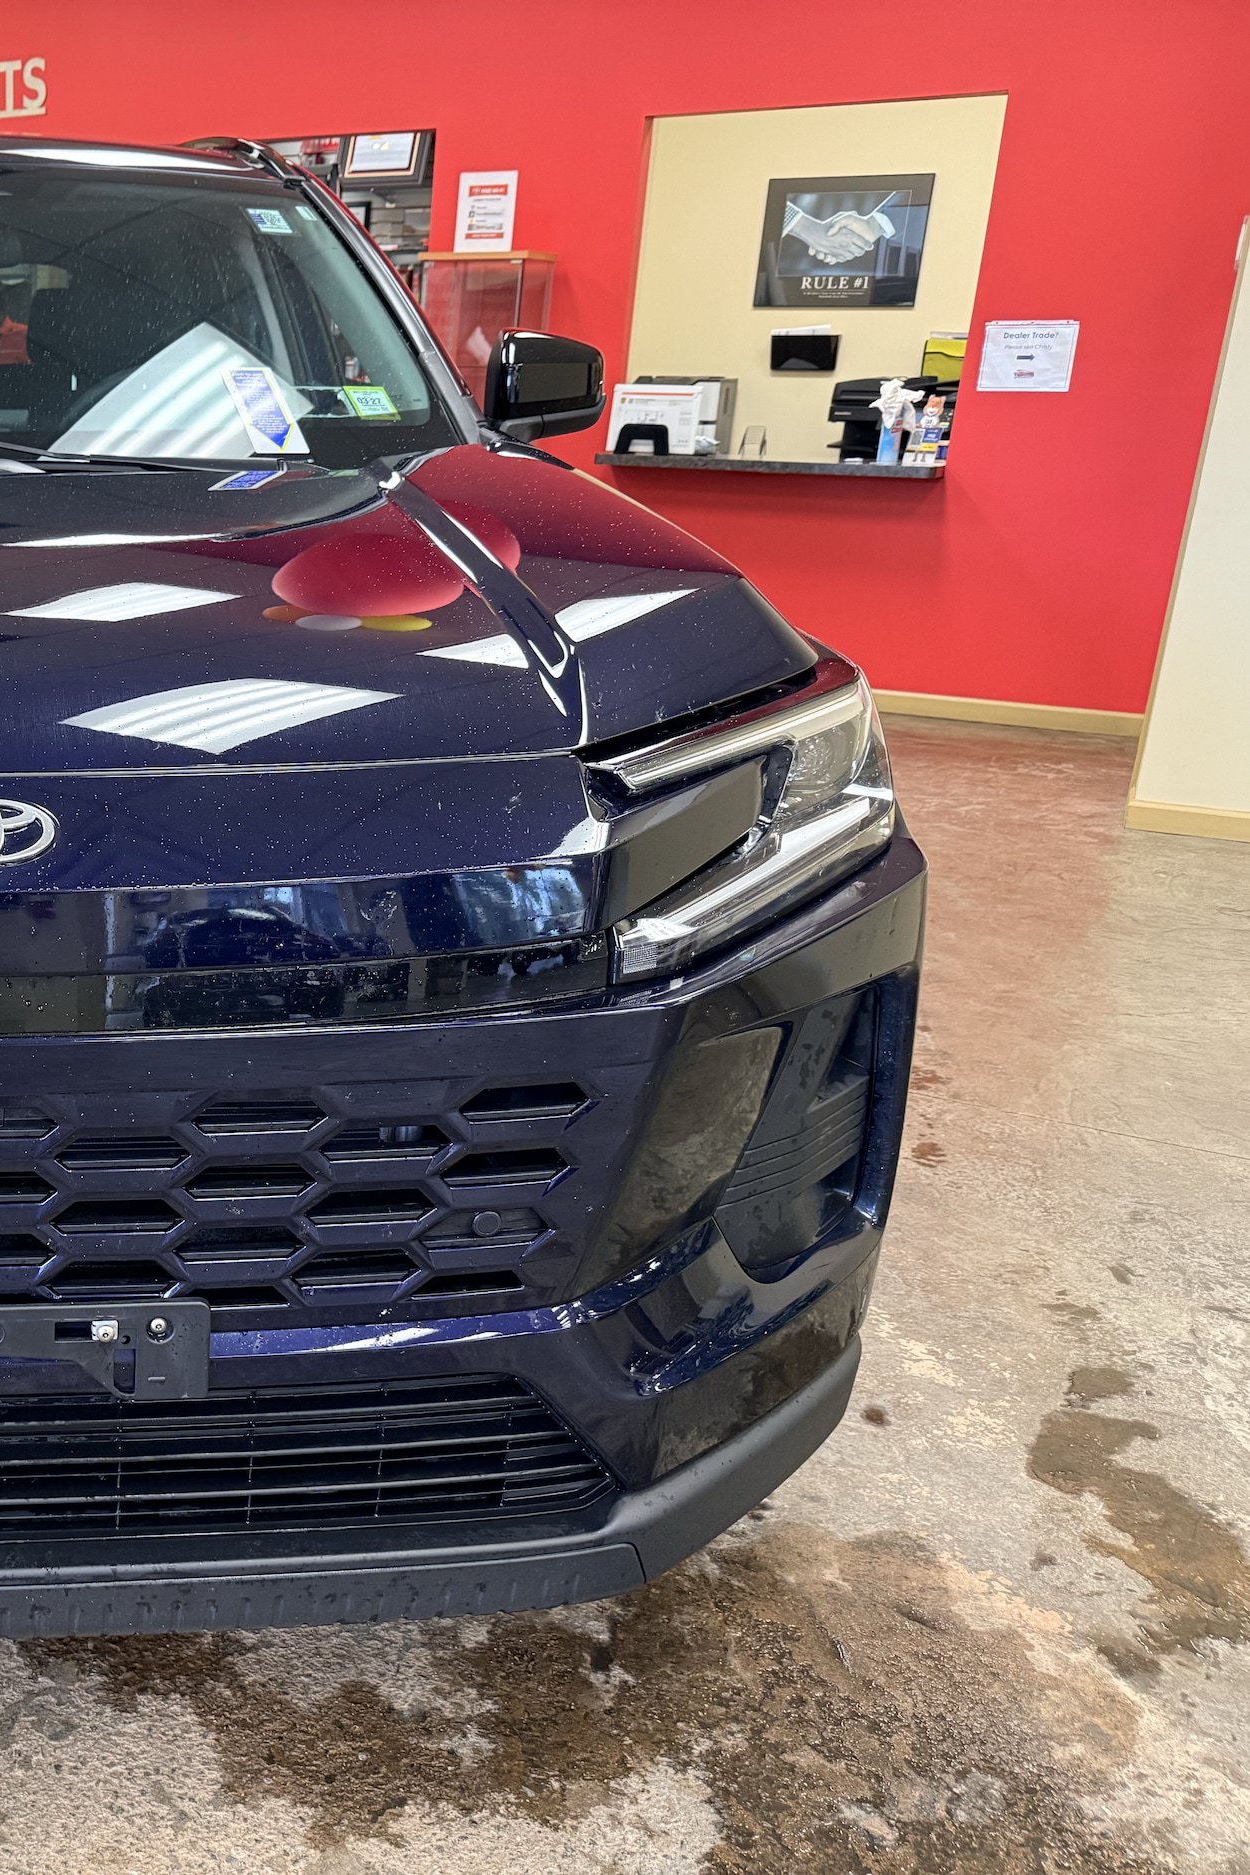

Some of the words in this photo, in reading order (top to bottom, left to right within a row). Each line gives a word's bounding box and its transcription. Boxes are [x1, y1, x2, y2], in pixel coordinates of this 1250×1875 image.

[800, 276, 850, 290] RULE
[853, 276, 869, 289] #1
[1003, 331, 1031, 340] Dealer
[1032, 331, 1060, 340] Trade?
